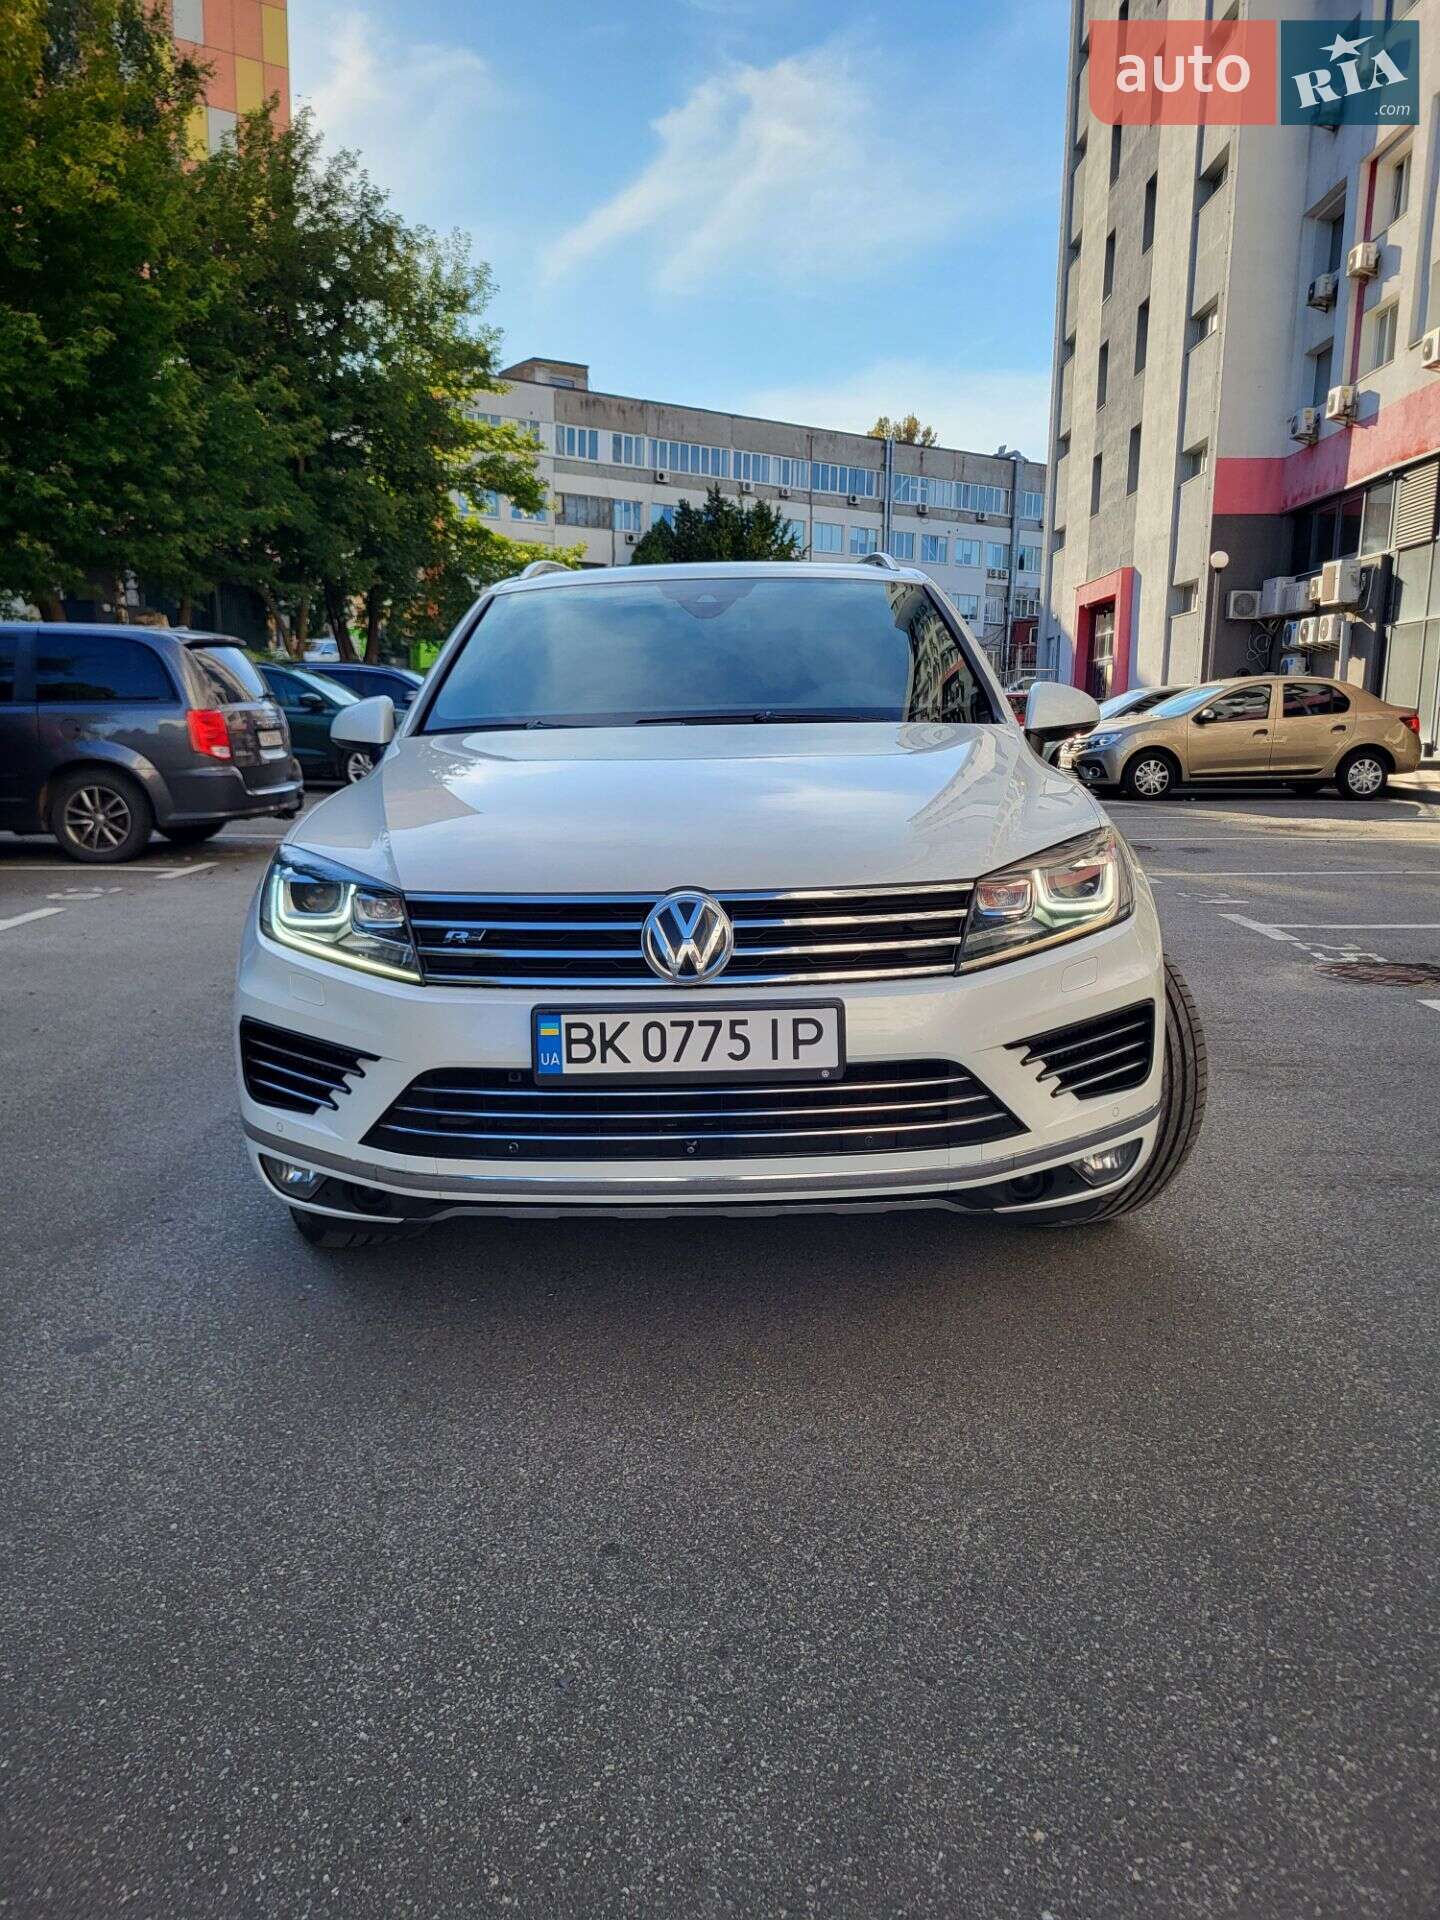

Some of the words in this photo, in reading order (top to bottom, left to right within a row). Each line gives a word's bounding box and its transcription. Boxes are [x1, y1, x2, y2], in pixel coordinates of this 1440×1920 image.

[565, 1021, 632, 1065] BK
[642, 1019, 751, 1063] 0775
[771, 1018, 824, 1060] IP
[540, 1052, 561, 1066] UA
